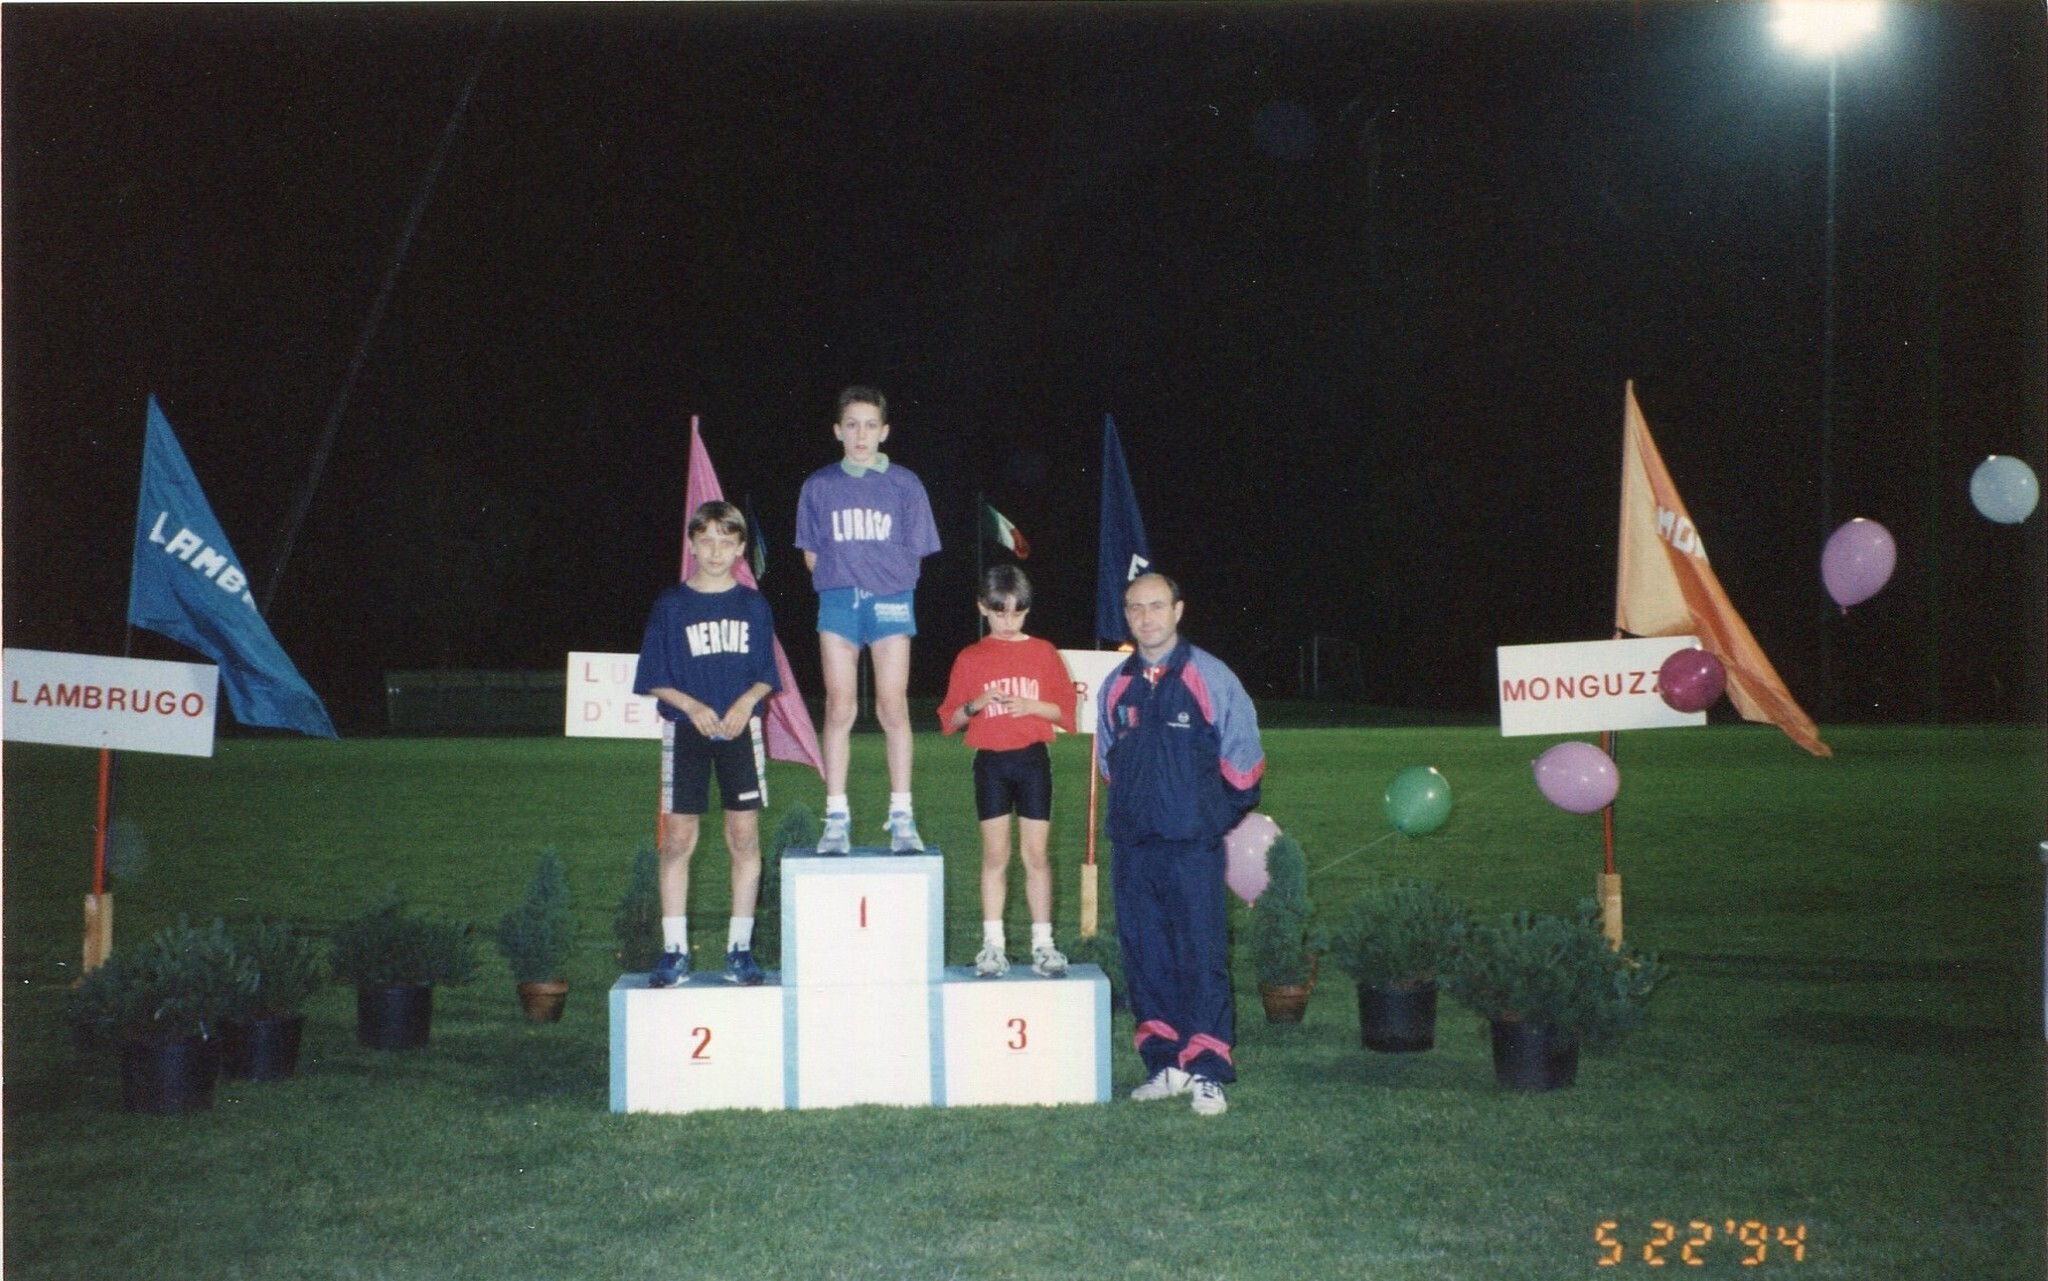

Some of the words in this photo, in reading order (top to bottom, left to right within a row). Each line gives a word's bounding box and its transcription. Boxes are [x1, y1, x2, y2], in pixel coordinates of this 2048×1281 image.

[832, 508, 891, 541] LURAGO
[685, 619, 749, 657] MERONE
[12, 680, 204, 717] LAMBRUGO
[860, 895, 867, 928] 1
[691, 1026, 711, 1059] 2
[1007, 1018, 1027, 1050] 3
